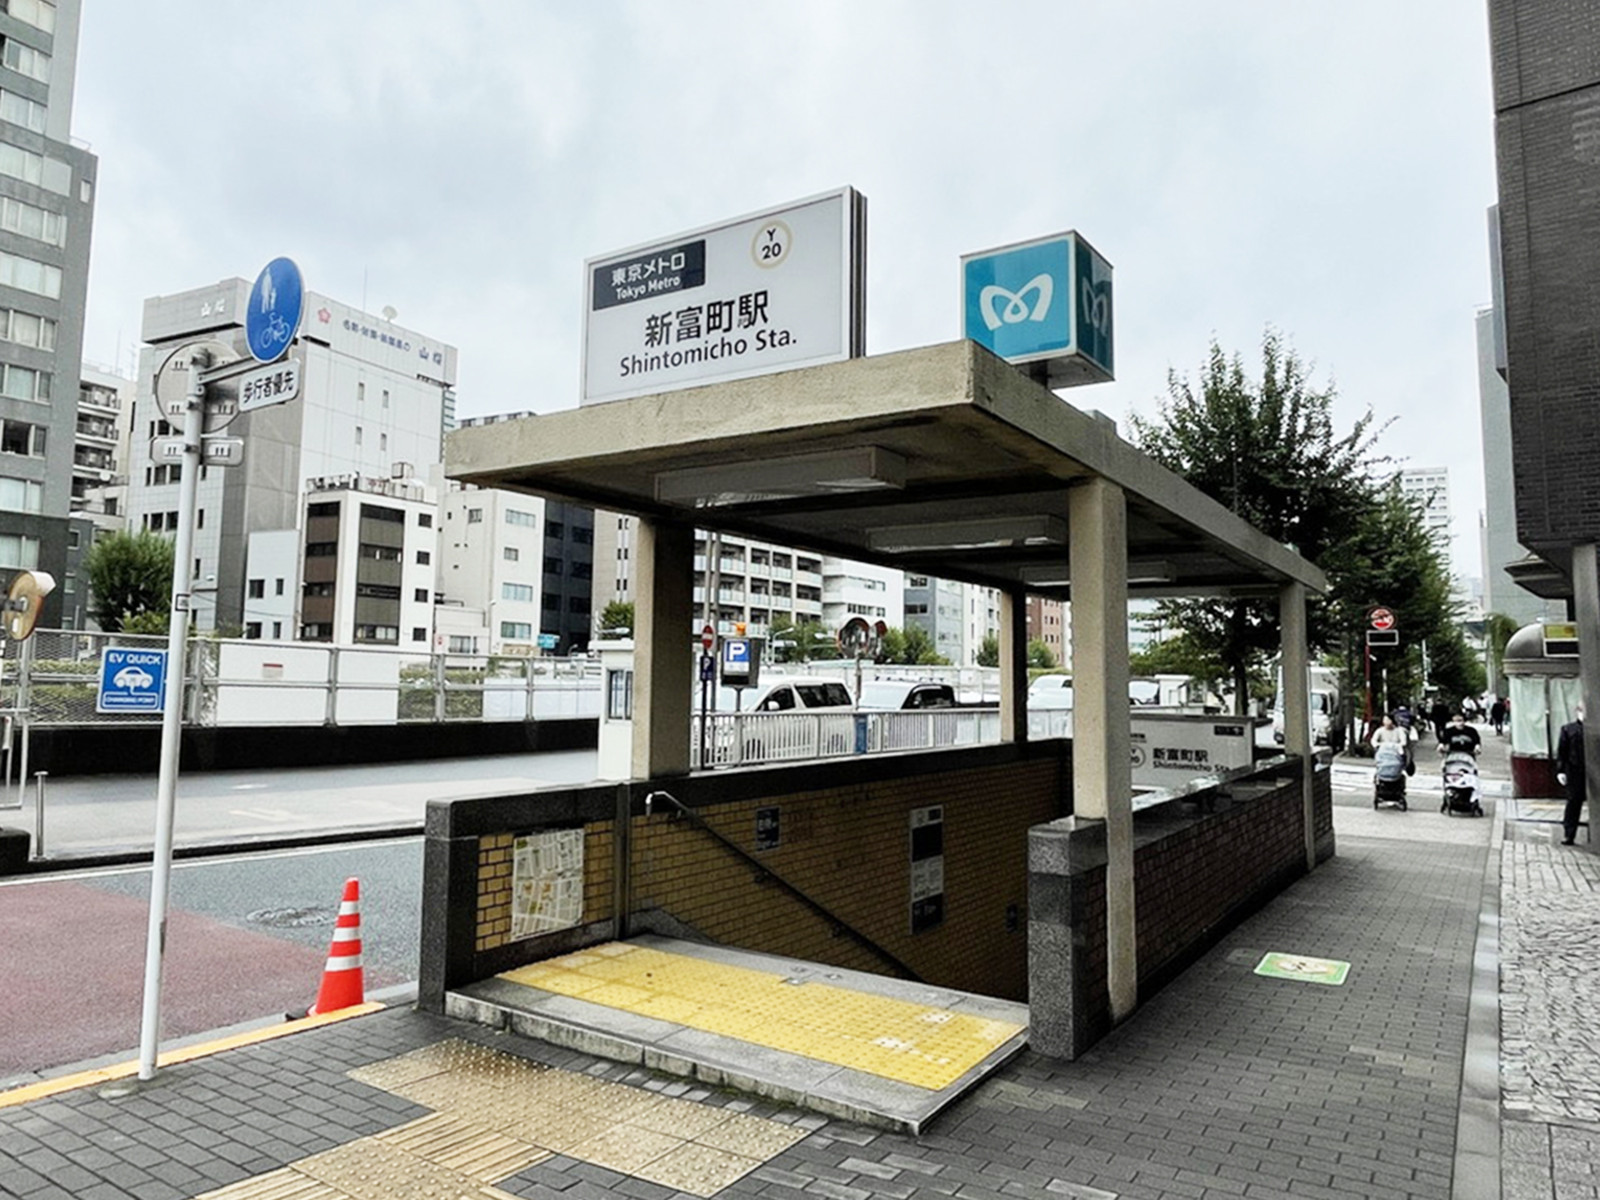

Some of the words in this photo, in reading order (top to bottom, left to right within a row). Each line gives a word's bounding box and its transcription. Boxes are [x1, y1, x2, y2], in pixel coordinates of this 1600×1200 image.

[766, 228, 776, 241] Y
[762, 242, 782, 259] 20
[611, 252, 685, 286] 東京メトロ
[616, 285, 647, 300] Tokyo
[648, 276, 681, 292] Metro
[644, 289, 769, 348] 新富町駅
[620, 336, 747, 377] Shintomicho
[755, 329, 797, 351] Sta.
[244, 370, 294, 404] 歩行者優先
[108, 653, 125, 663] EV
[126, 654, 161, 665] QUICK
[729, 643, 746, 661] P
[1153, 747, 1208, 762] 新富町駅
[1153, 761, 1212, 772] Shintomicho
